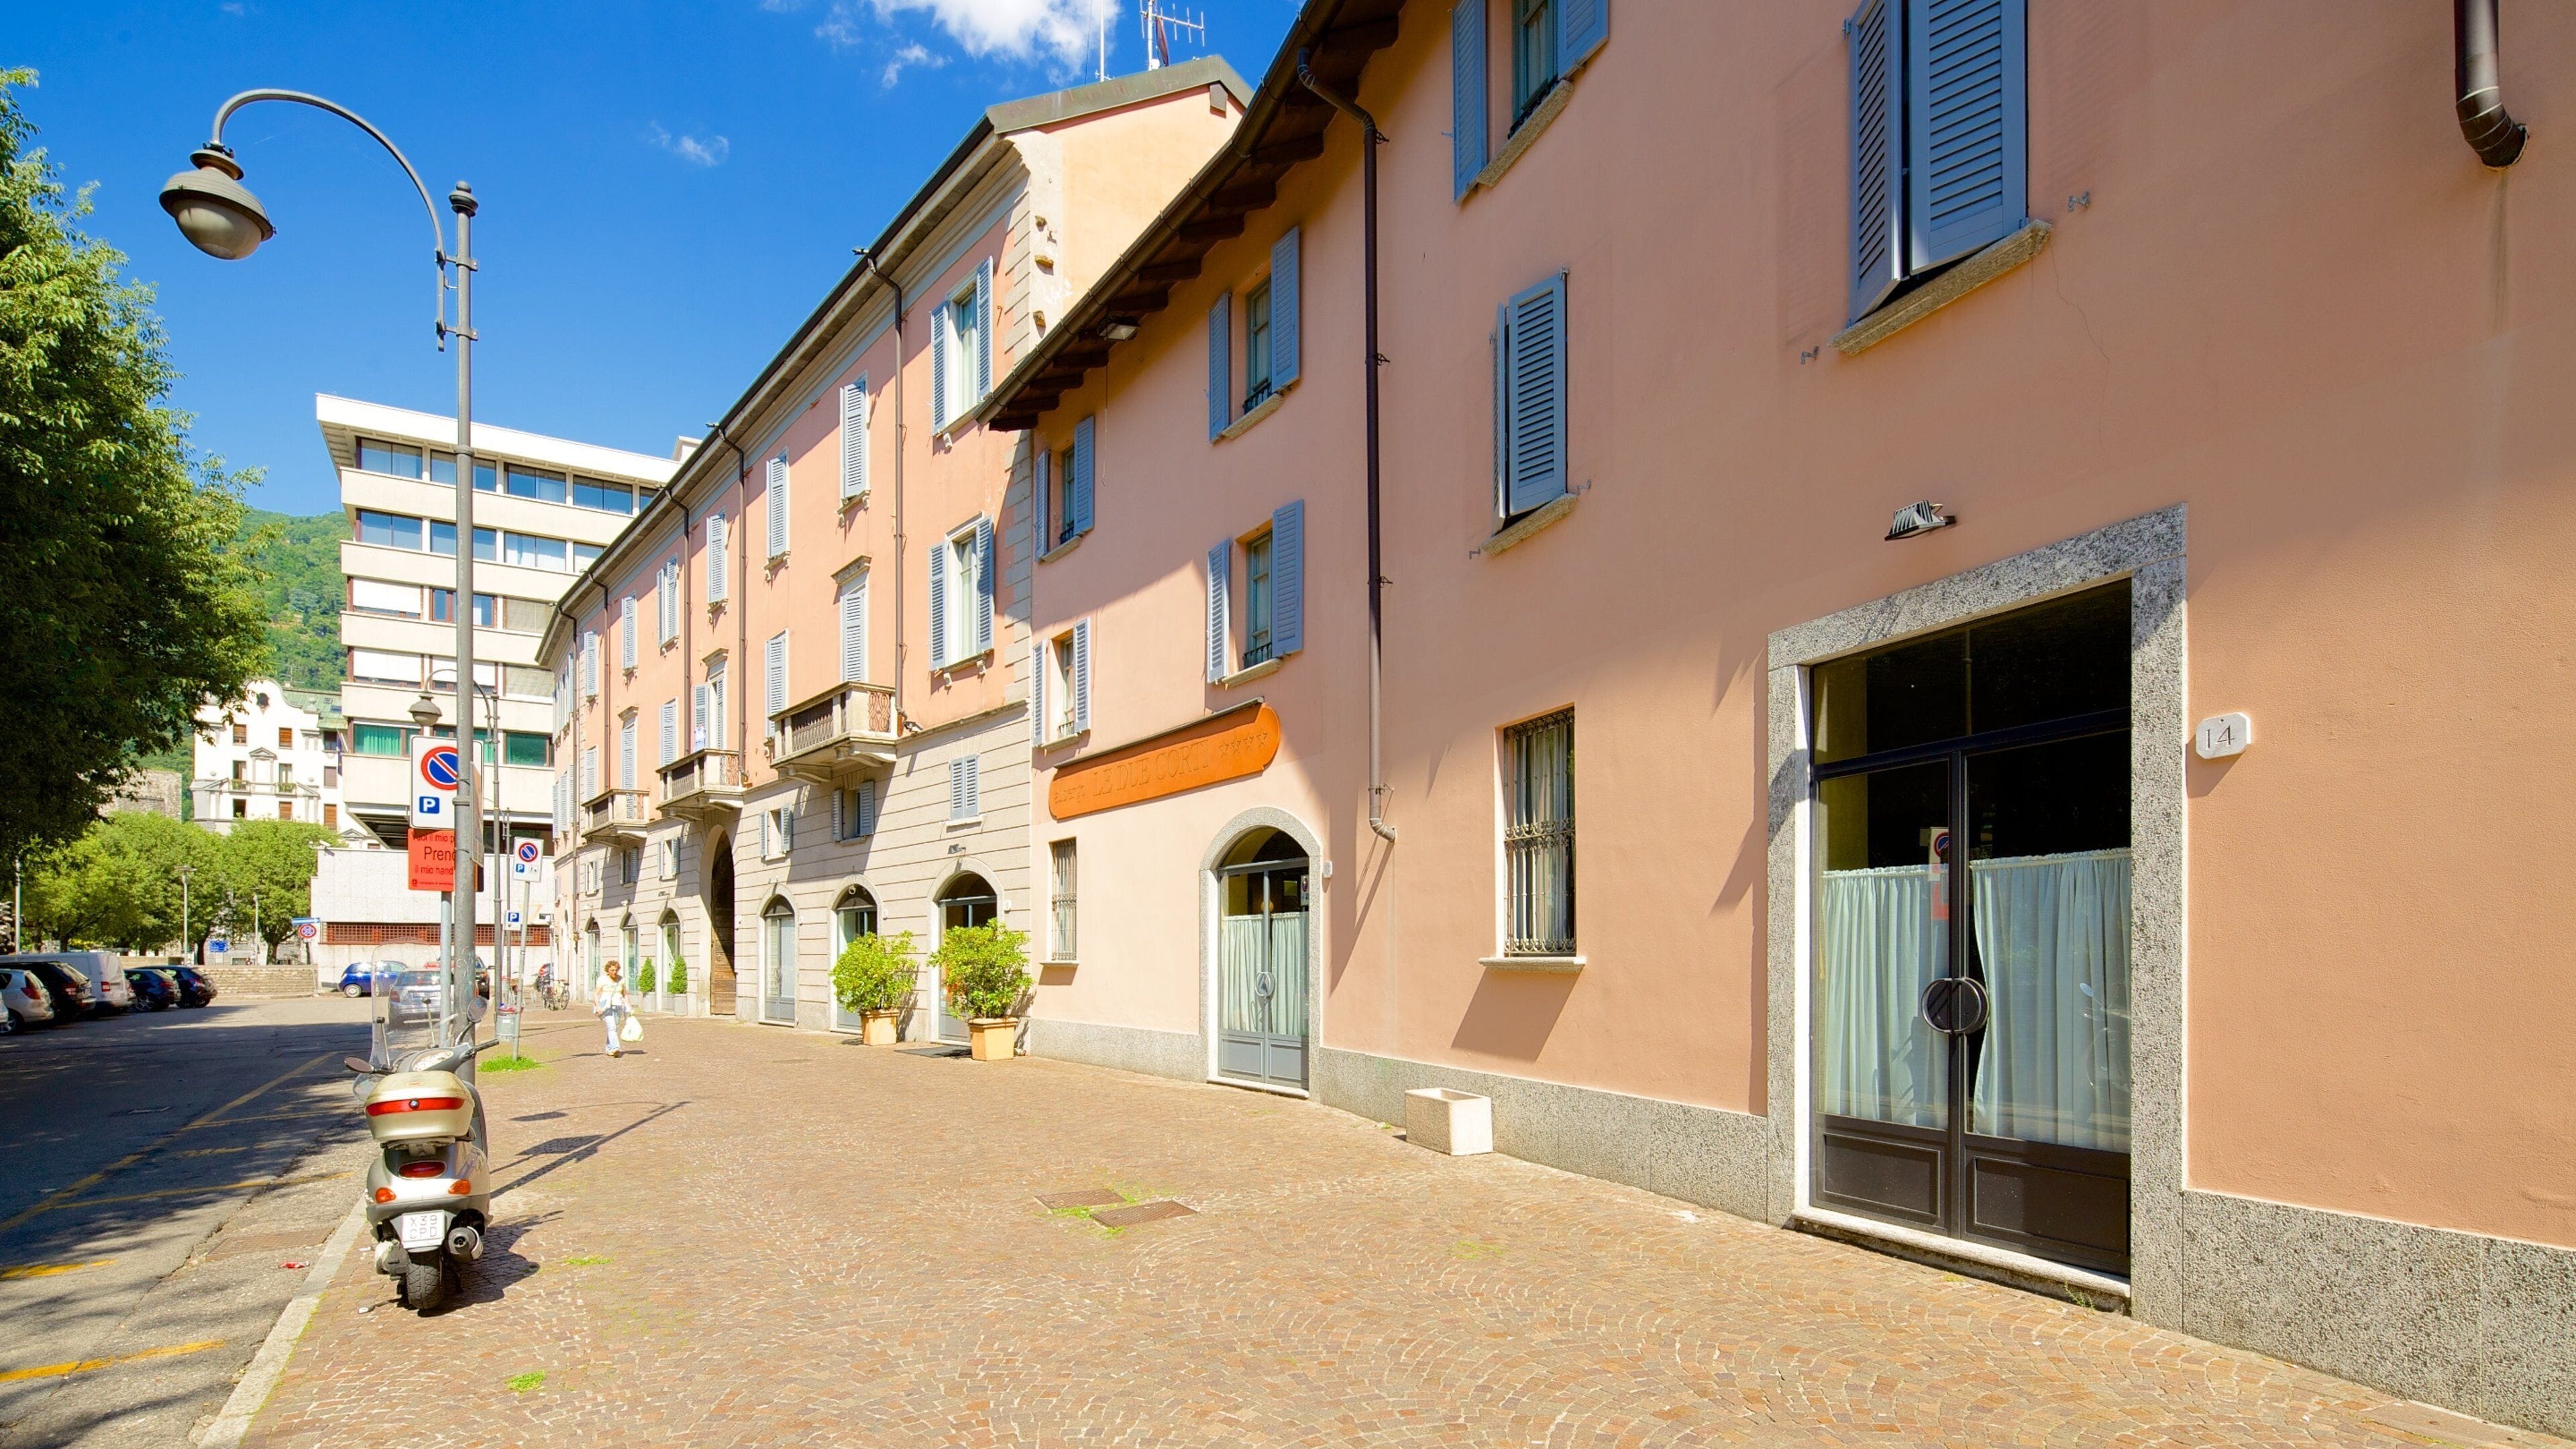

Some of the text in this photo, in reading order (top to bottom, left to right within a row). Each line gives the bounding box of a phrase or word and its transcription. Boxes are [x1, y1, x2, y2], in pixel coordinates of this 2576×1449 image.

[2206, 725, 2235, 749] 14
[423, 798, 436, 812] P
[435, 865, 454, 875] hand
